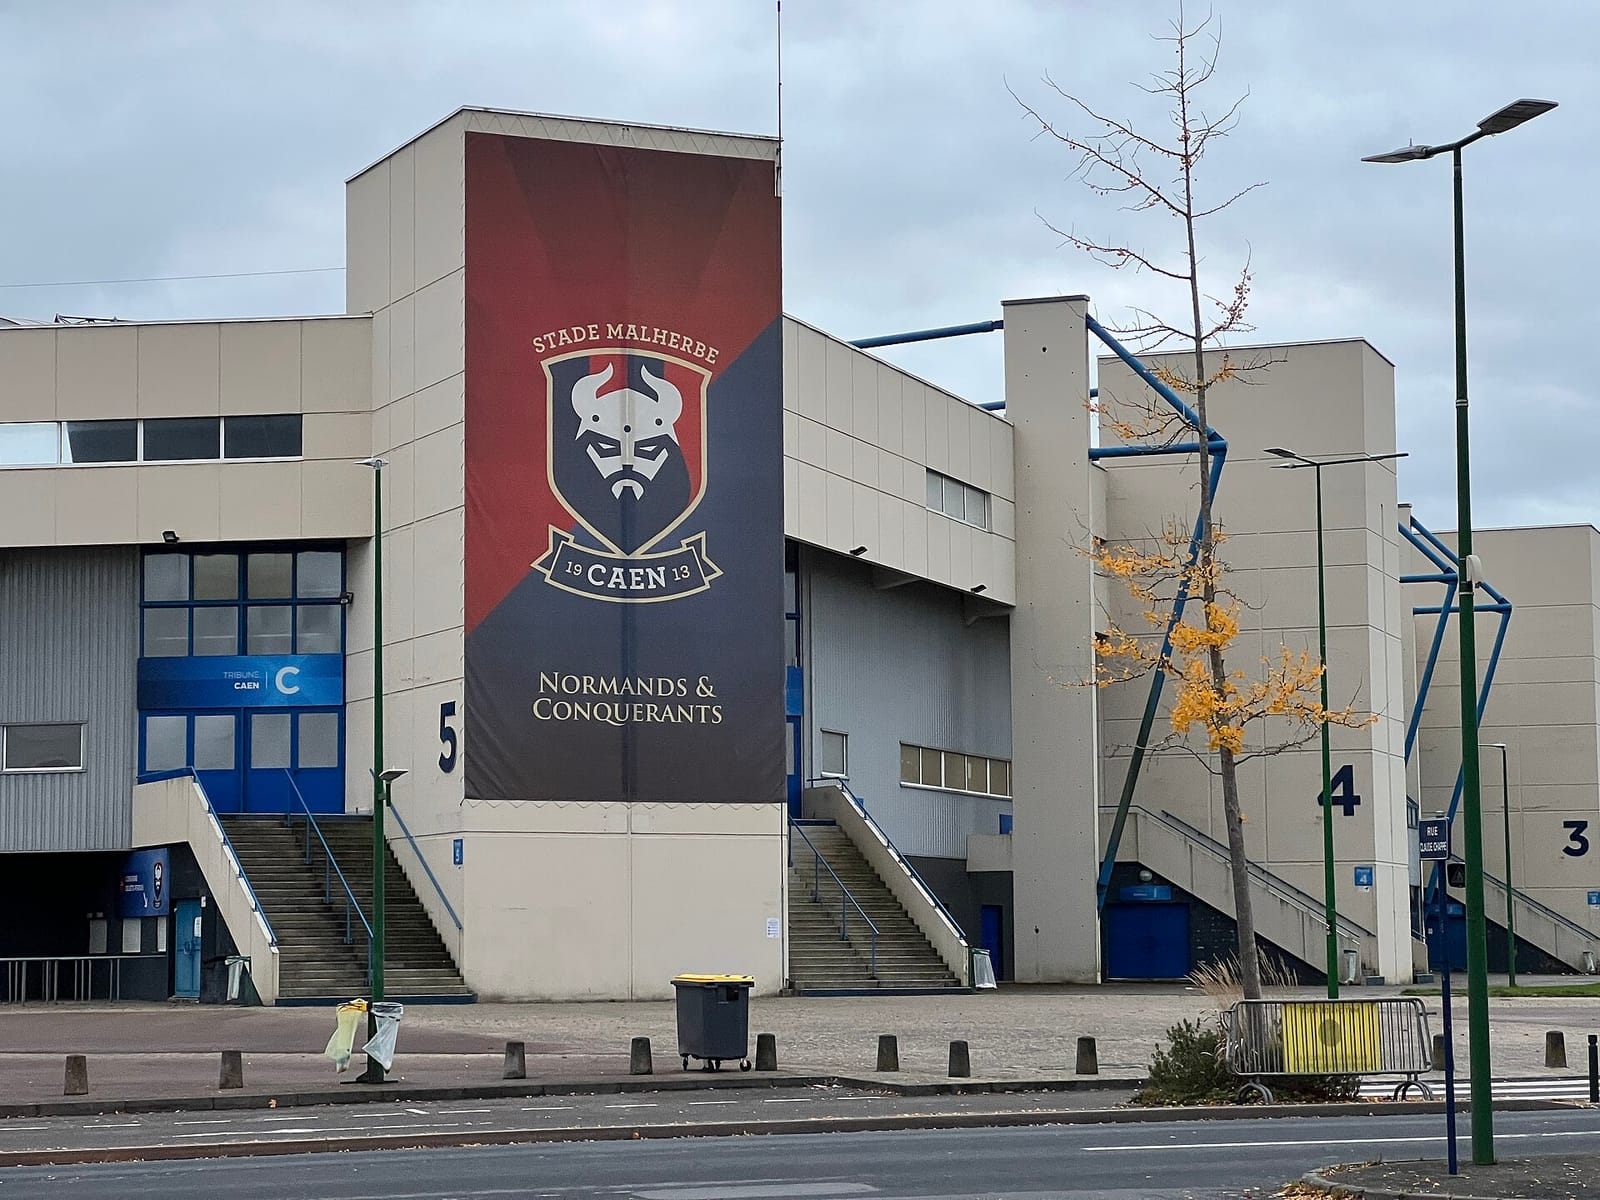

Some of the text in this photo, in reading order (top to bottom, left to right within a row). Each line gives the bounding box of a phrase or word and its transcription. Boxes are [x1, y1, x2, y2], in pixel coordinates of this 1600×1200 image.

[532, 322, 720, 365] STADE MALHERBE
[565, 560, 691, 591] 19 CAEN 13
[223, 671, 260, 680] TRIBUNE
[233, 682, 260, 691] CAEN
[275, 665, 301, 696] C
[537, 671, 718, 698] NORMANDS &
[532, 697, 723, 727] CONQUERANTS
[438, 700, 458, 775] 5
[1317, 764, 1362, 817] 4
[1426, 826, 1439, 837] RUE
[1561, 820, 1590, 858] 3
